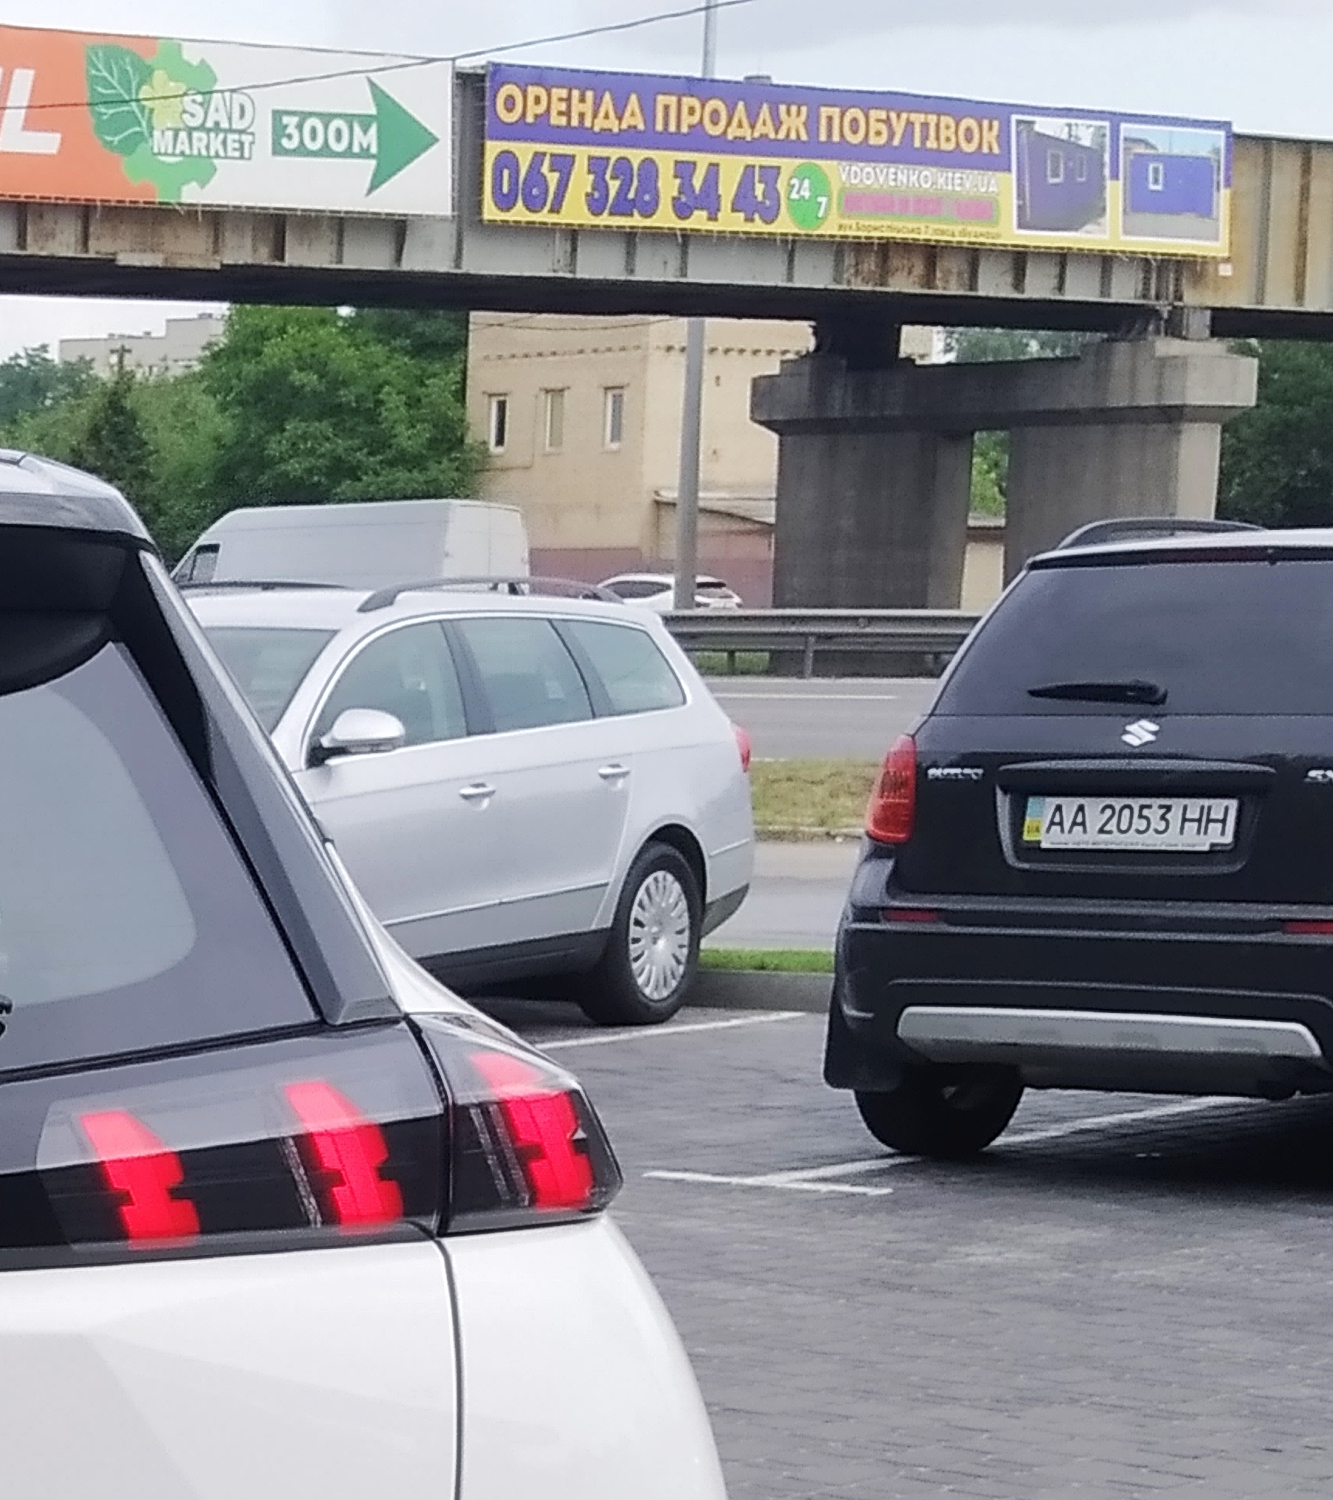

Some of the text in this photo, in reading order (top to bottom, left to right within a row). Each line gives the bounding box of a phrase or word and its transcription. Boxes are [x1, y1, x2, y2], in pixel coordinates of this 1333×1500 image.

[182, 90, 256, 131] SAD
[494, 82, 1001, 155] ОРЕНДА ПРОДАЖ ПОБУТІВОК
[152, 129, 255, 160] MARKET
[491, 150, 782, 225] 067 328 34 43
[789, 177, 812, 200] 24
[838, 164, 1000, 193] VDOVENKO.KIEV.UA
[816, 195, 828, 218] 7
[1045, 803, 1230, 837] AA 2053 HH
